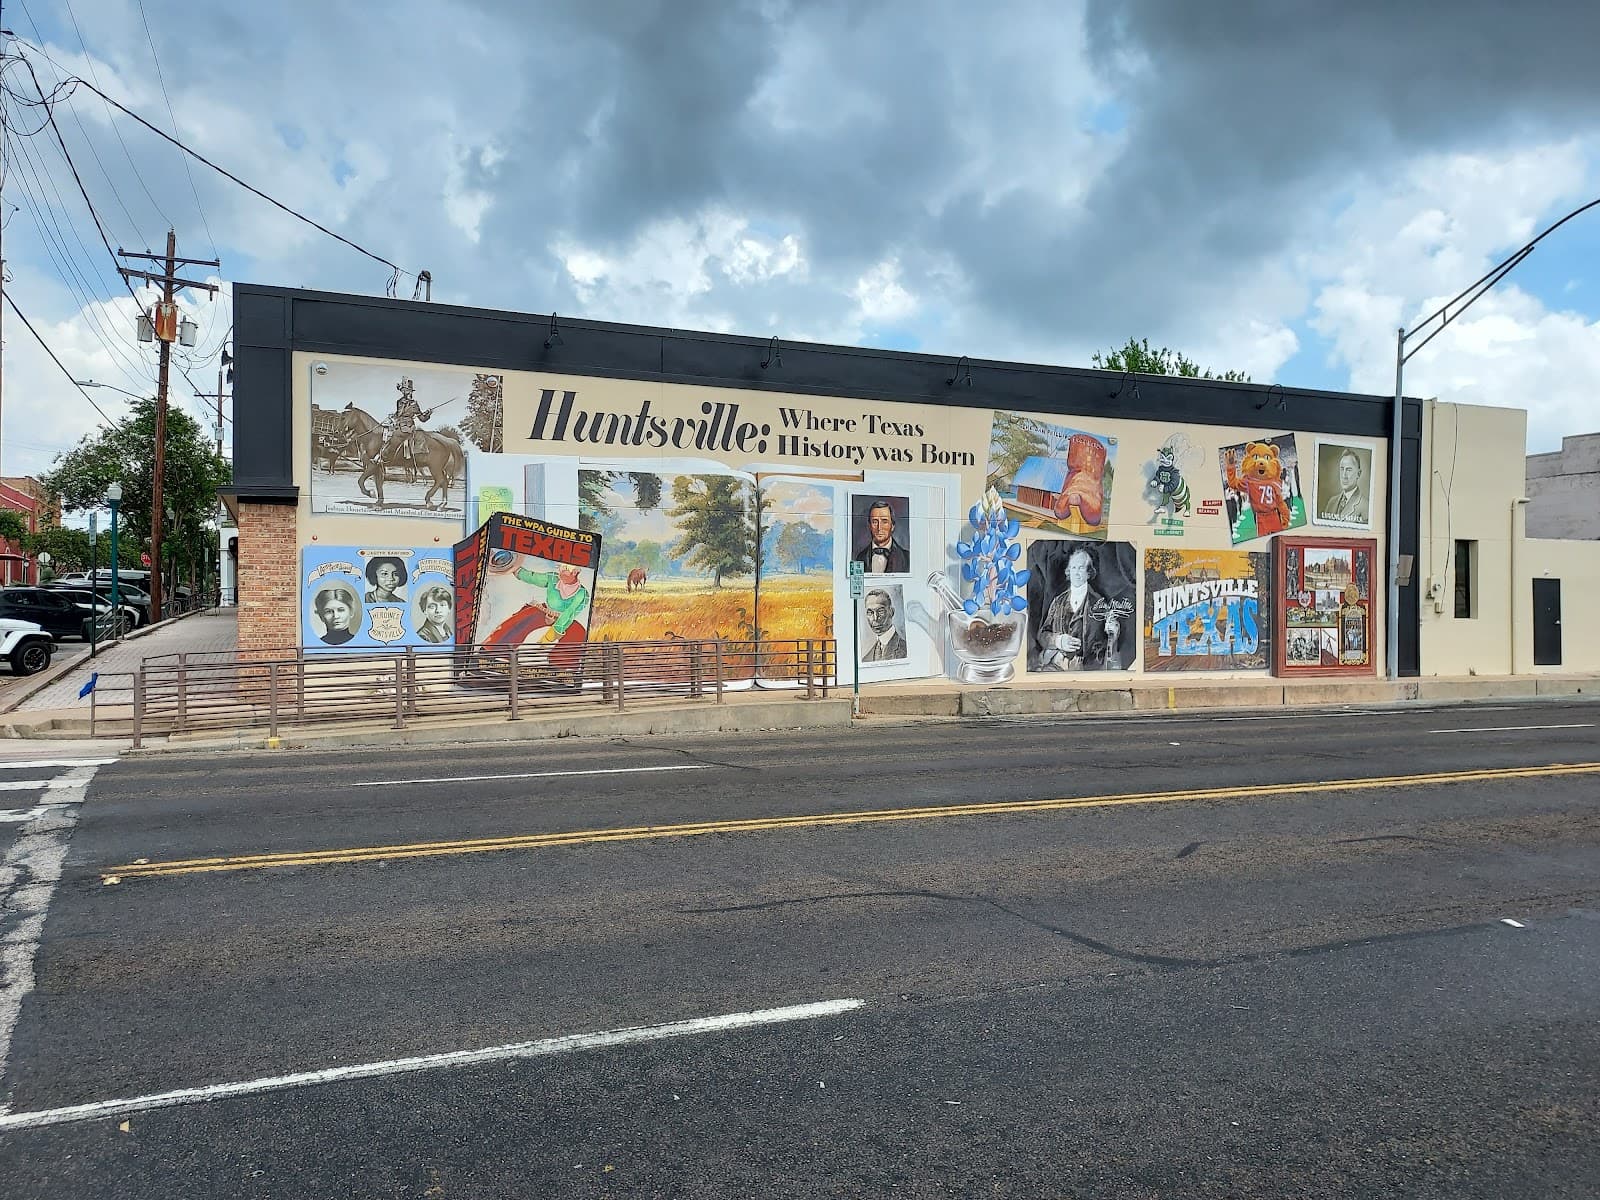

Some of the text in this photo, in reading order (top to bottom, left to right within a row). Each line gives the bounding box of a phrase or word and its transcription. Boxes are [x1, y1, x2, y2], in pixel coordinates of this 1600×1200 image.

[525, 388, 771, 454] Huntsville:
[779, 407, 924, 437] Where Texas
[776, 434, 975, 466] History was Born
[1258, 485, 1273, 505] 79
[500, 525, 592, 566] TEXAS
[502, 515, 593, 542] THE WPA GUIDE TO
[456, 534, 480, 644] TEXAS
[1153, 578, 1259, 624] HUNTSVILLE
[1152, 596, 1259, 656] TEXAS
